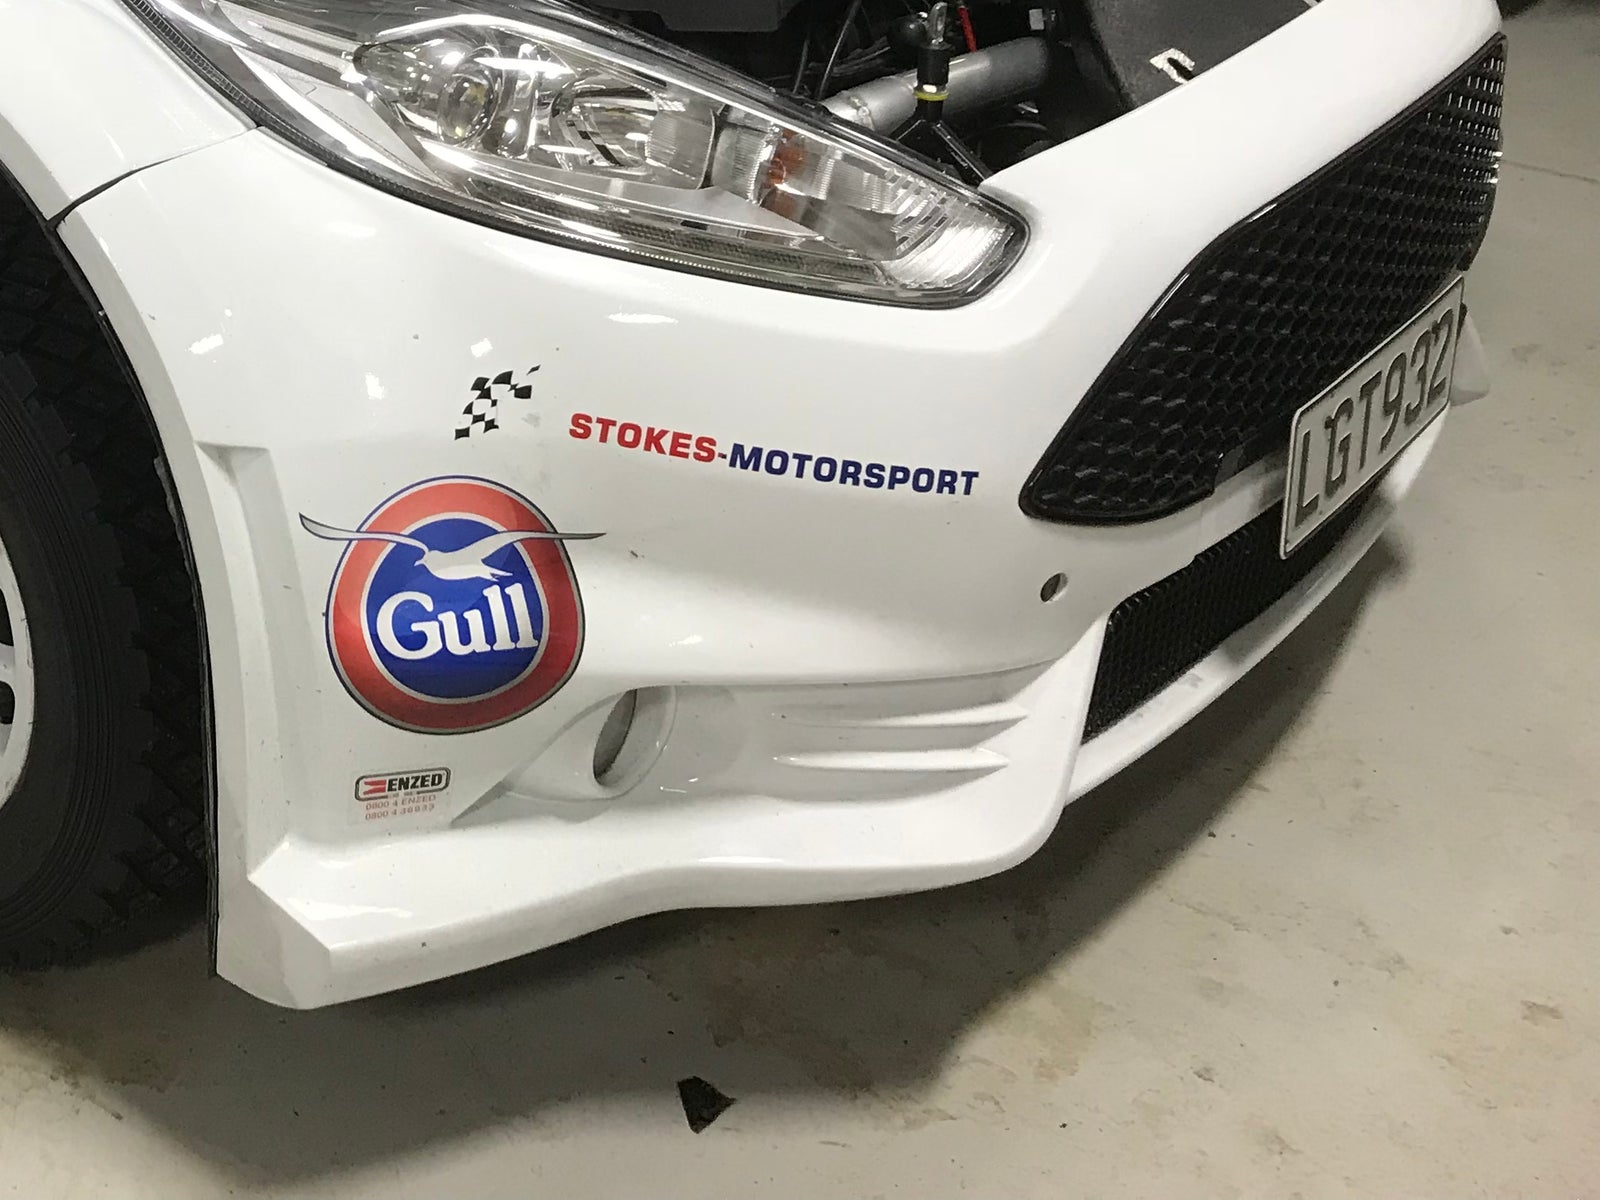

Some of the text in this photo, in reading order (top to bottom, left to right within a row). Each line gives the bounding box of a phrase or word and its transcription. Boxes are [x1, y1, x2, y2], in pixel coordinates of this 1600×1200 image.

[568, 412, 980, 497] STOKES-MOTORSPORT
[1295, 307, 1454, 528] LGT932
[376, 582, 539, 660] Gull
[386, 772, 443, 793] ENZED
